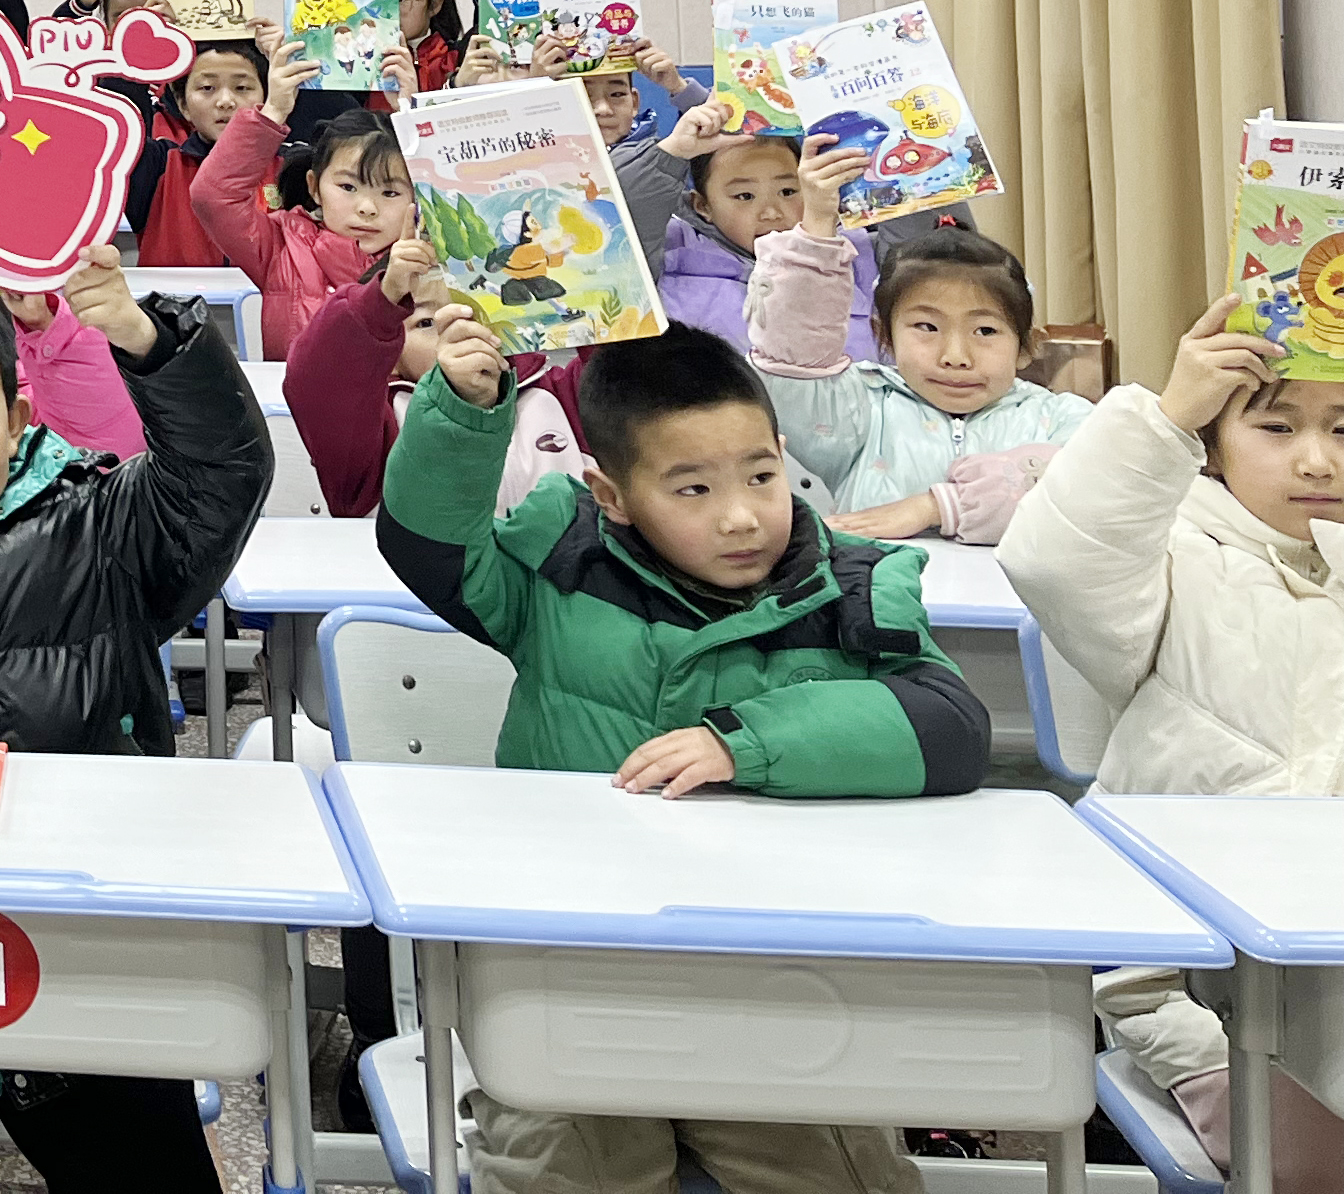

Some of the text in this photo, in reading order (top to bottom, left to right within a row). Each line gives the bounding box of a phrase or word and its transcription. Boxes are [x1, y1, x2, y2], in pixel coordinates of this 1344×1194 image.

[39, 29, 93, 53] PIU
[841, 66, 904, 97] 百问百答
[907, 90, 941, 111] 海洋
[911, 110, 954, 131] 与海底
[437, 127, 557, 165] 宝葫芦的秘密
